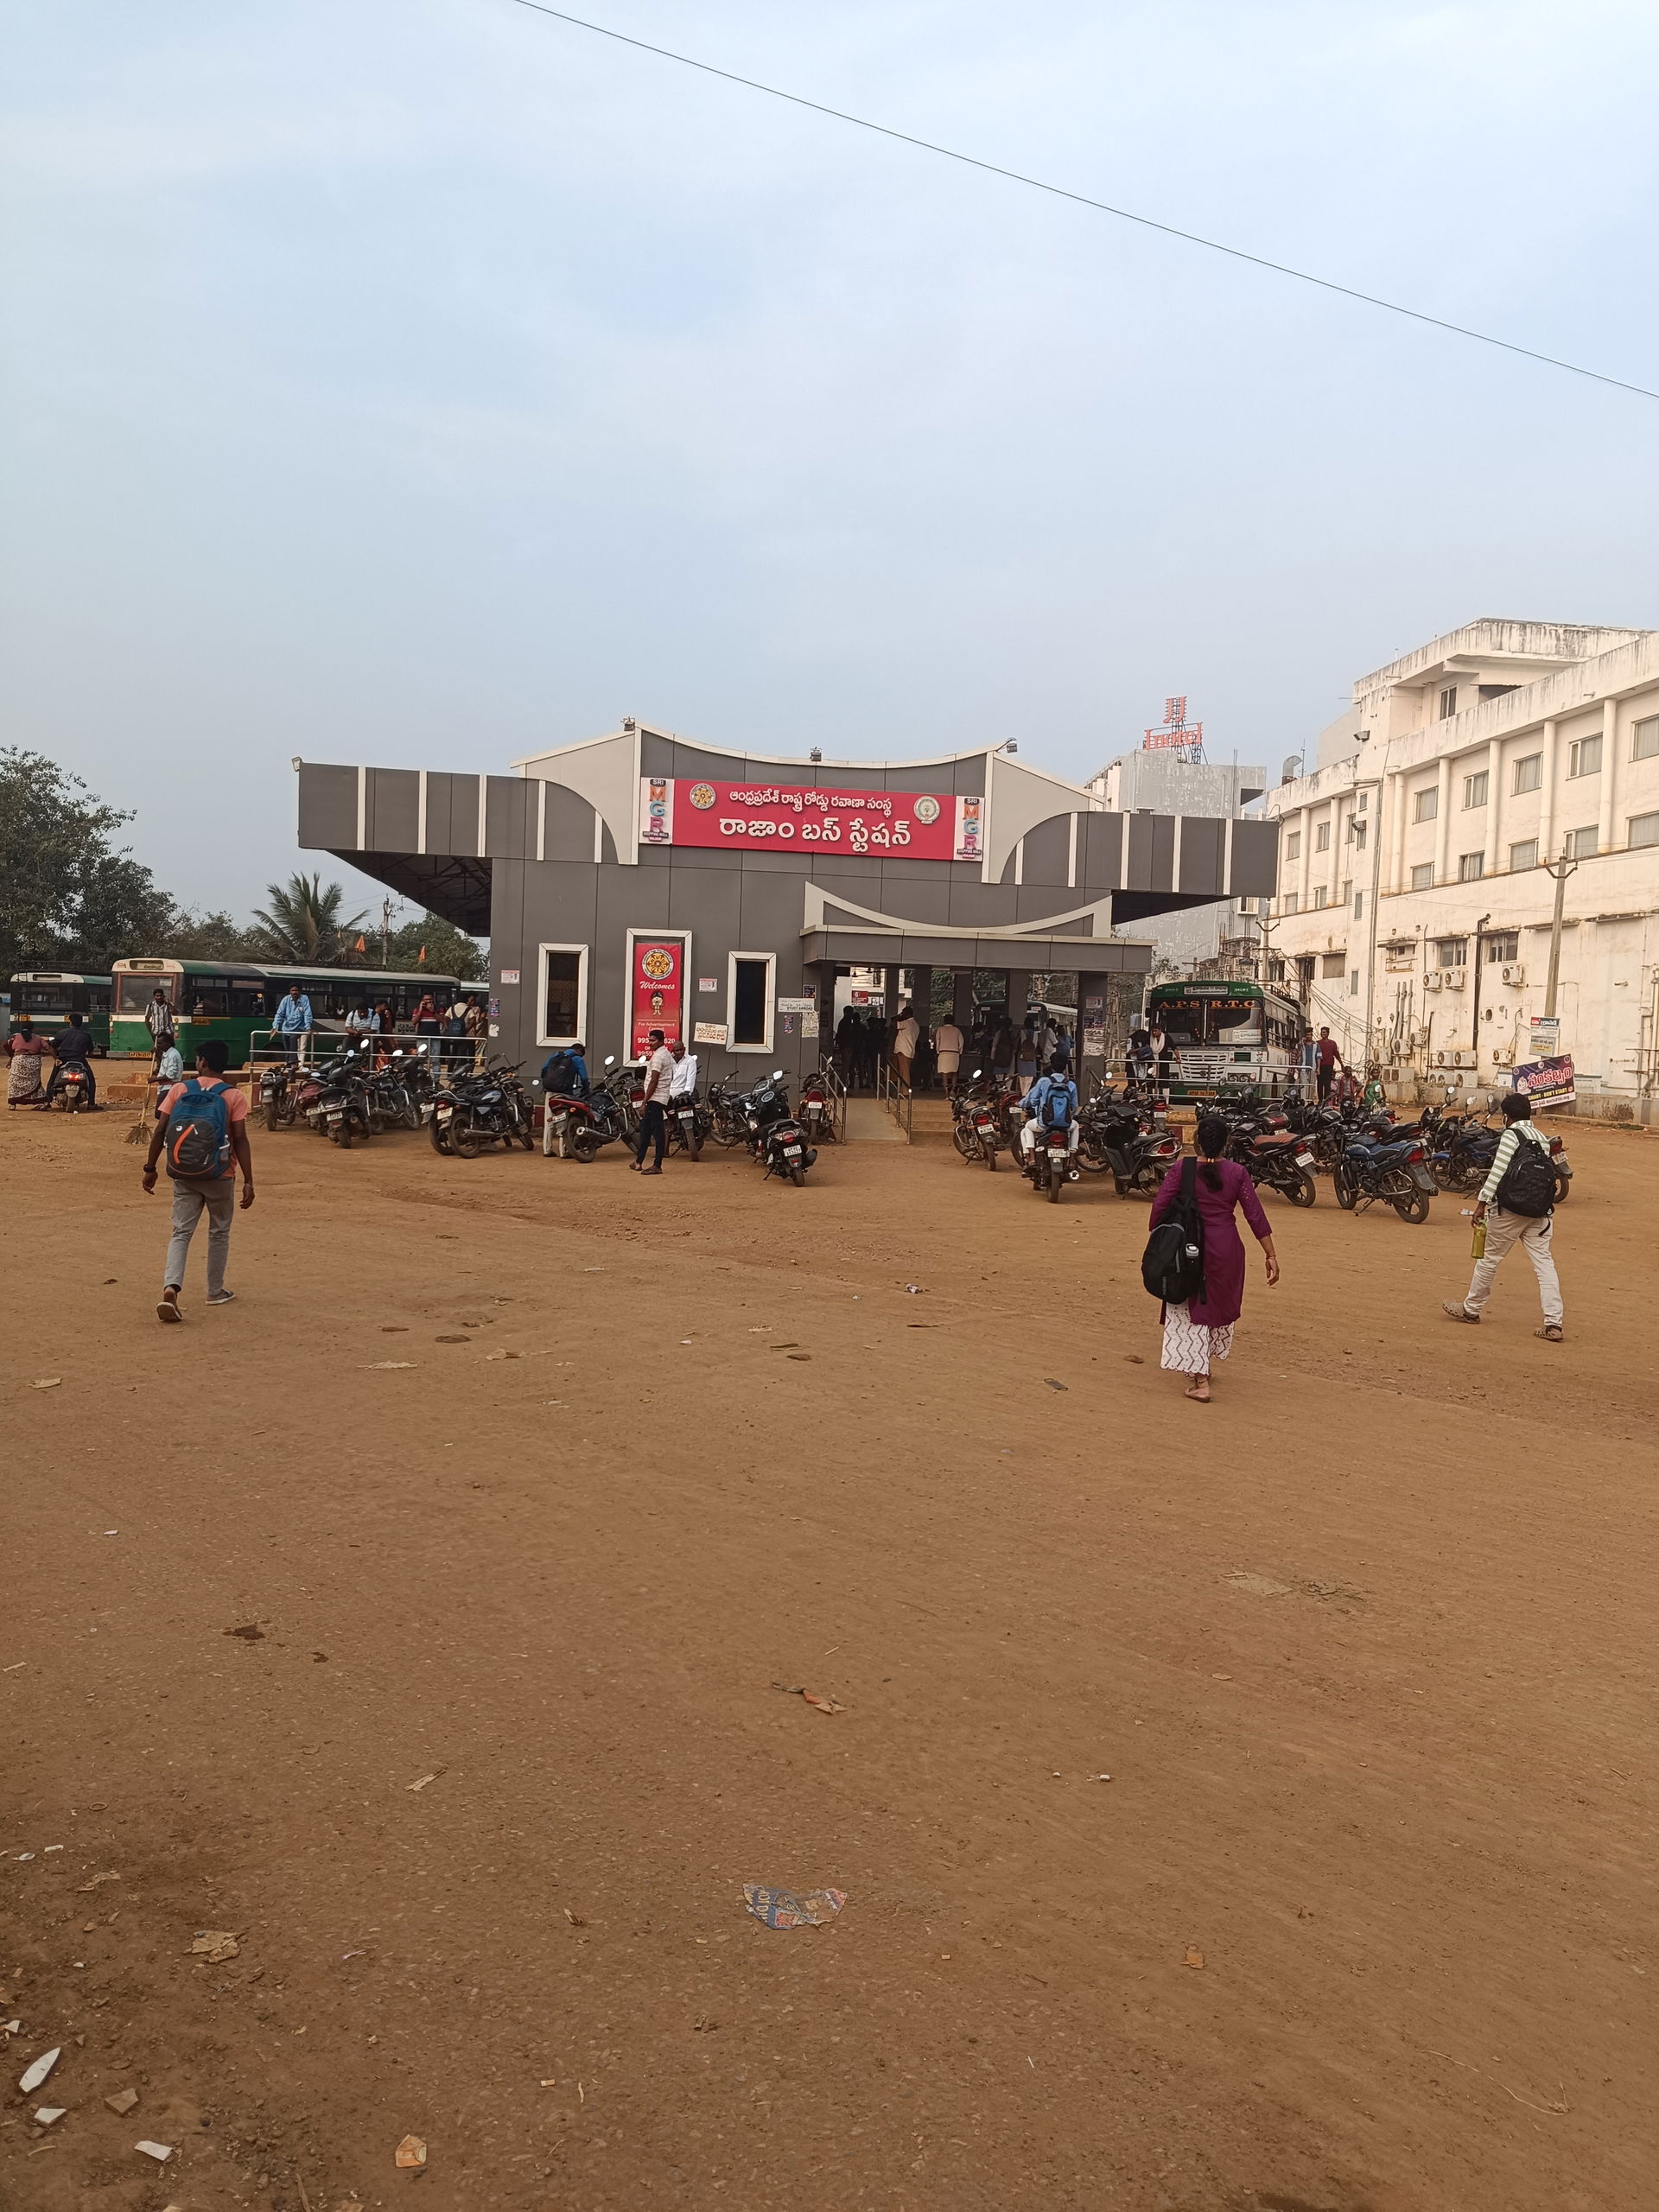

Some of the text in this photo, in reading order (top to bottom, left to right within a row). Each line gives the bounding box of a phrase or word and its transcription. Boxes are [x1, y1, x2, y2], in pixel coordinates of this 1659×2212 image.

[729, 788, 780, 806] ఆంధ్రప్రదేశ్
[781, 792, 803, 812] రాష్ట్ర
[804, 791, 829, 811] రోడ్డు
[831, 795, 865, 809] రవాణా
[867, 797, 893, 817] సంస్థ
[719, 817, 912, 853] రాజాం బస్ స్టేషన్
[639, 981, 676, 990] Welcomes
